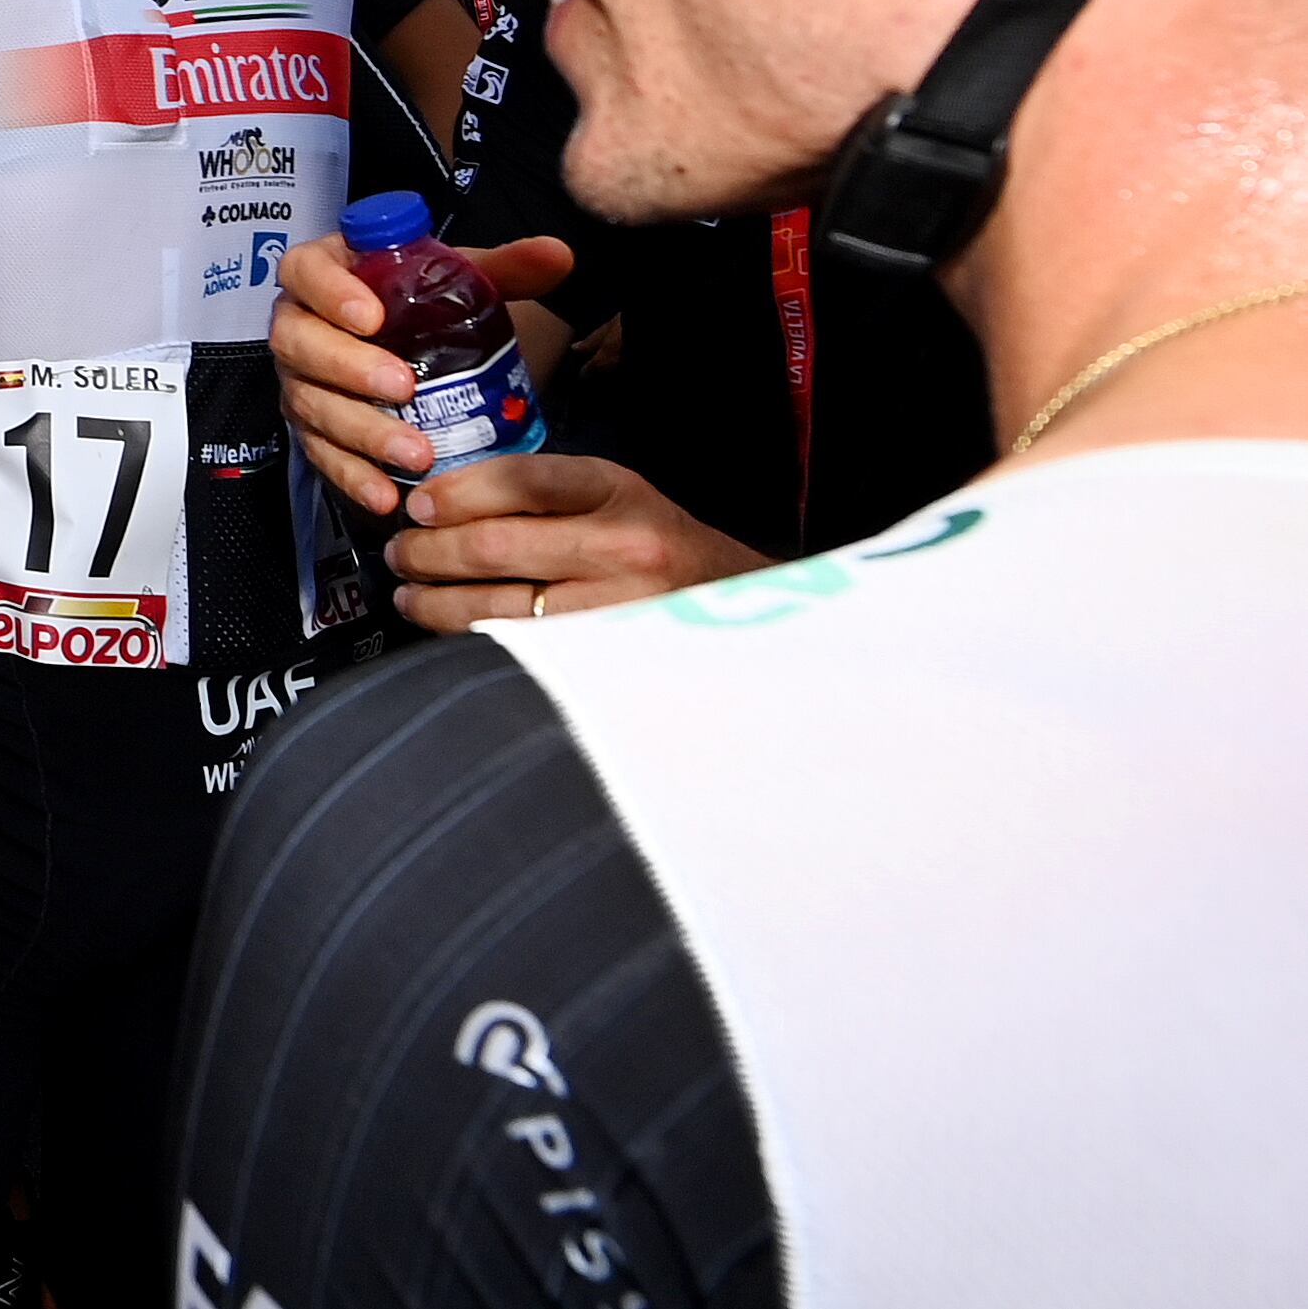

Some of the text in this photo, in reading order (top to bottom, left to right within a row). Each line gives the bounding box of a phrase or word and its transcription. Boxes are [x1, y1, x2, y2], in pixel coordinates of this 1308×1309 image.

[151, 42, 329, 110] Emirates
[199, 147, 295, 179] WHOOSH
[219, 202, 292, 224] COLNAGO
[31, 365, 160, 391] M. SOLER
[3, 412, 153, 580] 17
